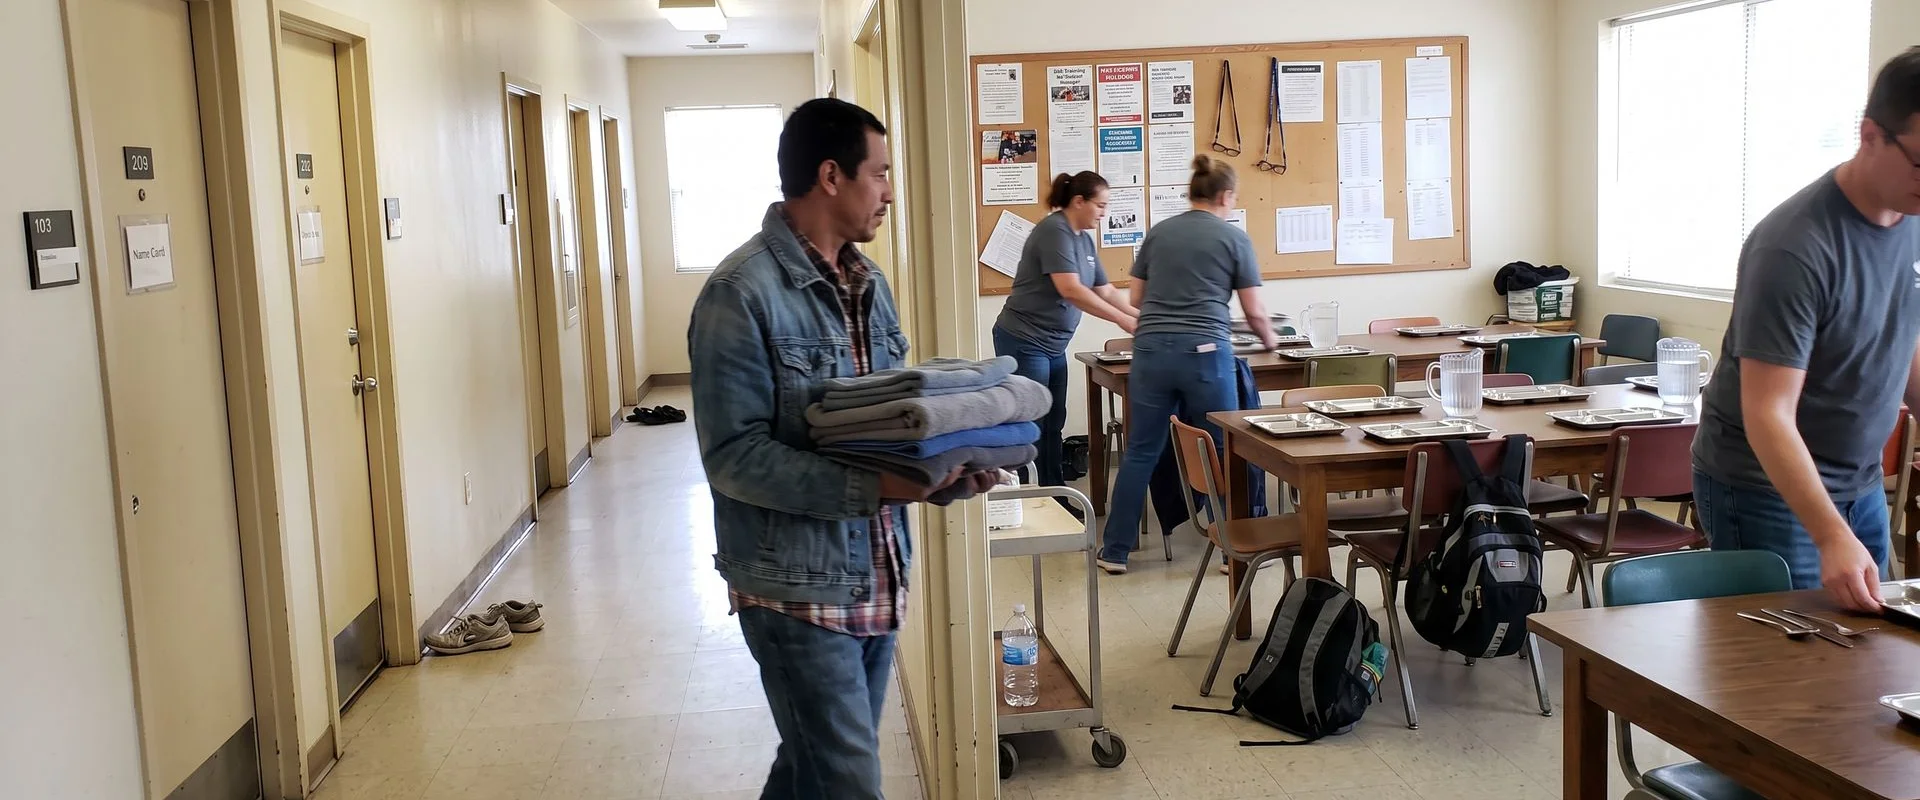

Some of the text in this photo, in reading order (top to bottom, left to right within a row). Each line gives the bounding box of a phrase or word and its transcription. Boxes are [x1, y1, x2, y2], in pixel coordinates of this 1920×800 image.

[131, 155, 149, 171] 209
[34, 218, 52, 234] 103
[132, 245, 166, 261] Name Card
